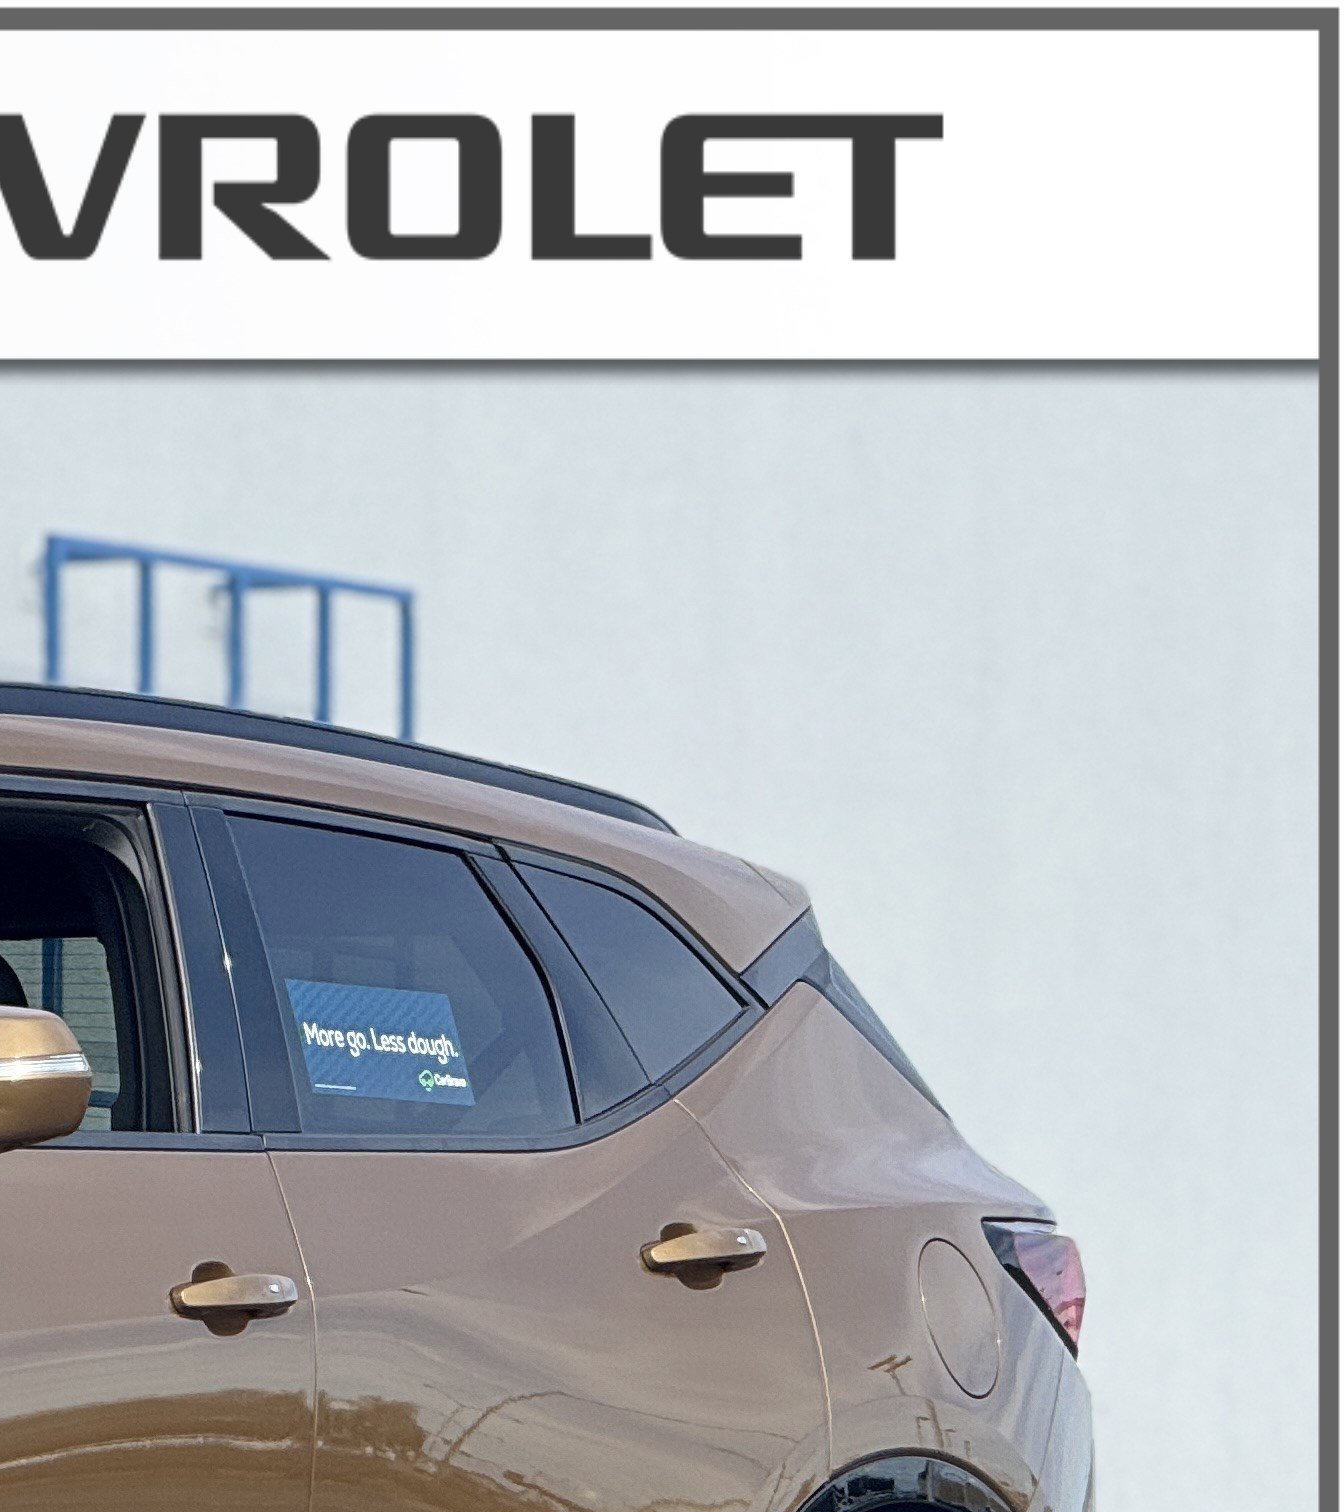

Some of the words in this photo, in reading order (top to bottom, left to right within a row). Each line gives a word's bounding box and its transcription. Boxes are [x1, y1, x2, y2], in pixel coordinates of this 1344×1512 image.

[302, 1021, 345, 1048] More
[347, 1029, 371, 1058] go.
[370, 1027, 407, 1054] Less
[407, 1031, 459, 1065] dough.
